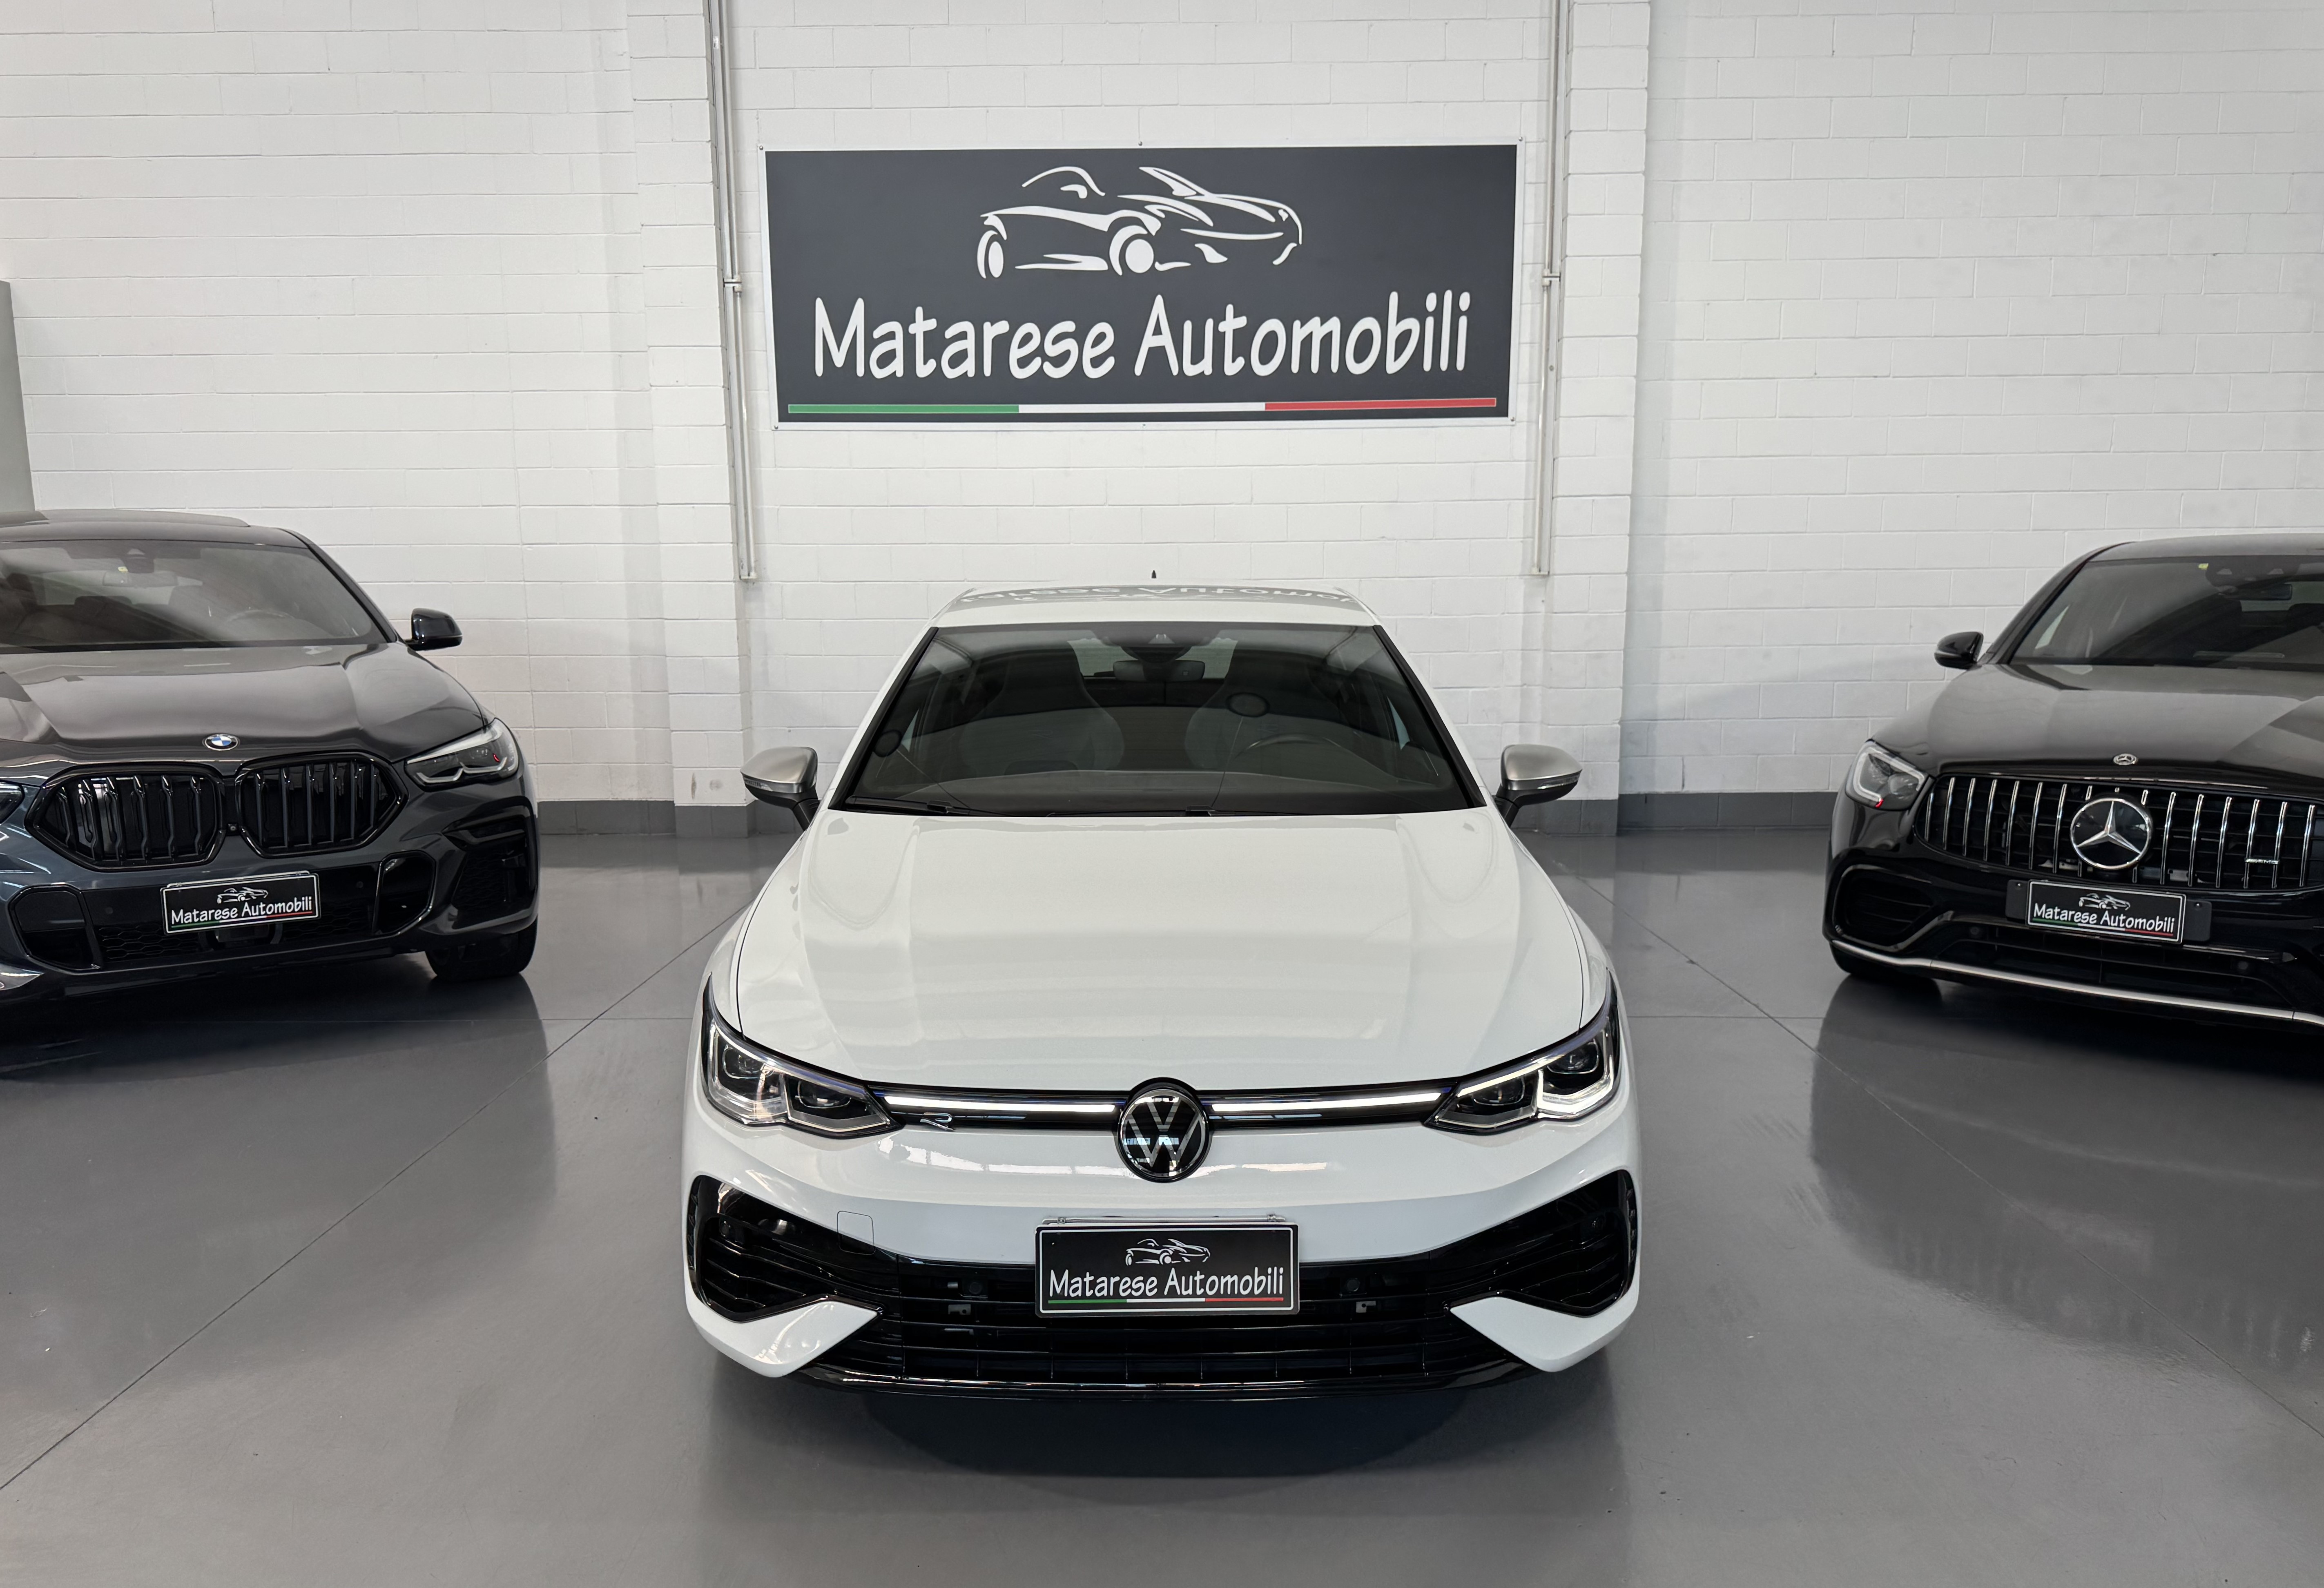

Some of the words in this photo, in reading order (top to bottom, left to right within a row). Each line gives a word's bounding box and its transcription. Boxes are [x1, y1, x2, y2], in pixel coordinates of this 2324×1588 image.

[814, 297, 1116, 380] Matarese
[1134, 289, 1471, 377] Automobili
[171, 908, 238, 925] Matarese
[241, 896, 312, 917] Automobili
[2034, 903, 2097, 924] Matarese
[2100, 910, 2175, 933] Automobili
[1049, 1269, 1158, 1298] Matarese
[1163, 1266, 1284, 1296] Automobili
